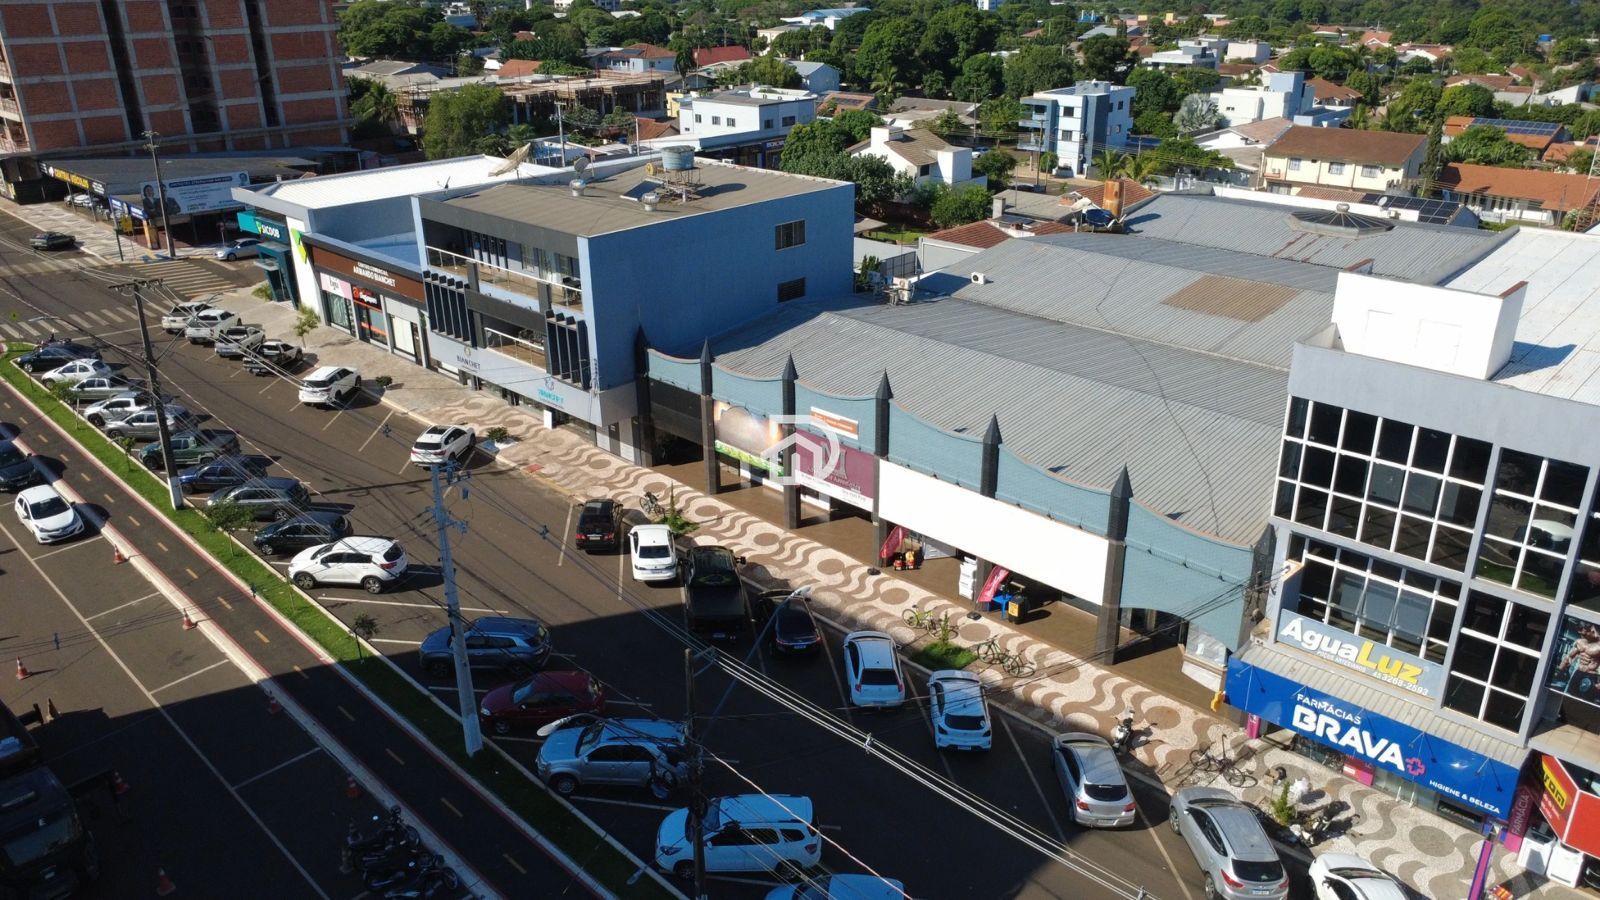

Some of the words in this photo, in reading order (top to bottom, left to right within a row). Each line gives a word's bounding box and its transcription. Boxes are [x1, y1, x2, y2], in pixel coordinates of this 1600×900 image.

[1297, 693, 1361, 725] FARMÁCIAS
[1291, 704, 1405, 772] BRAVA
[1429, 779, 1460, 797] HIGIENE
[1461, 792, 1468, 801] &
[1469, 796, 1500, 814] BELEZA
[1511, 794, 1530, 835] FARMÁCIA
